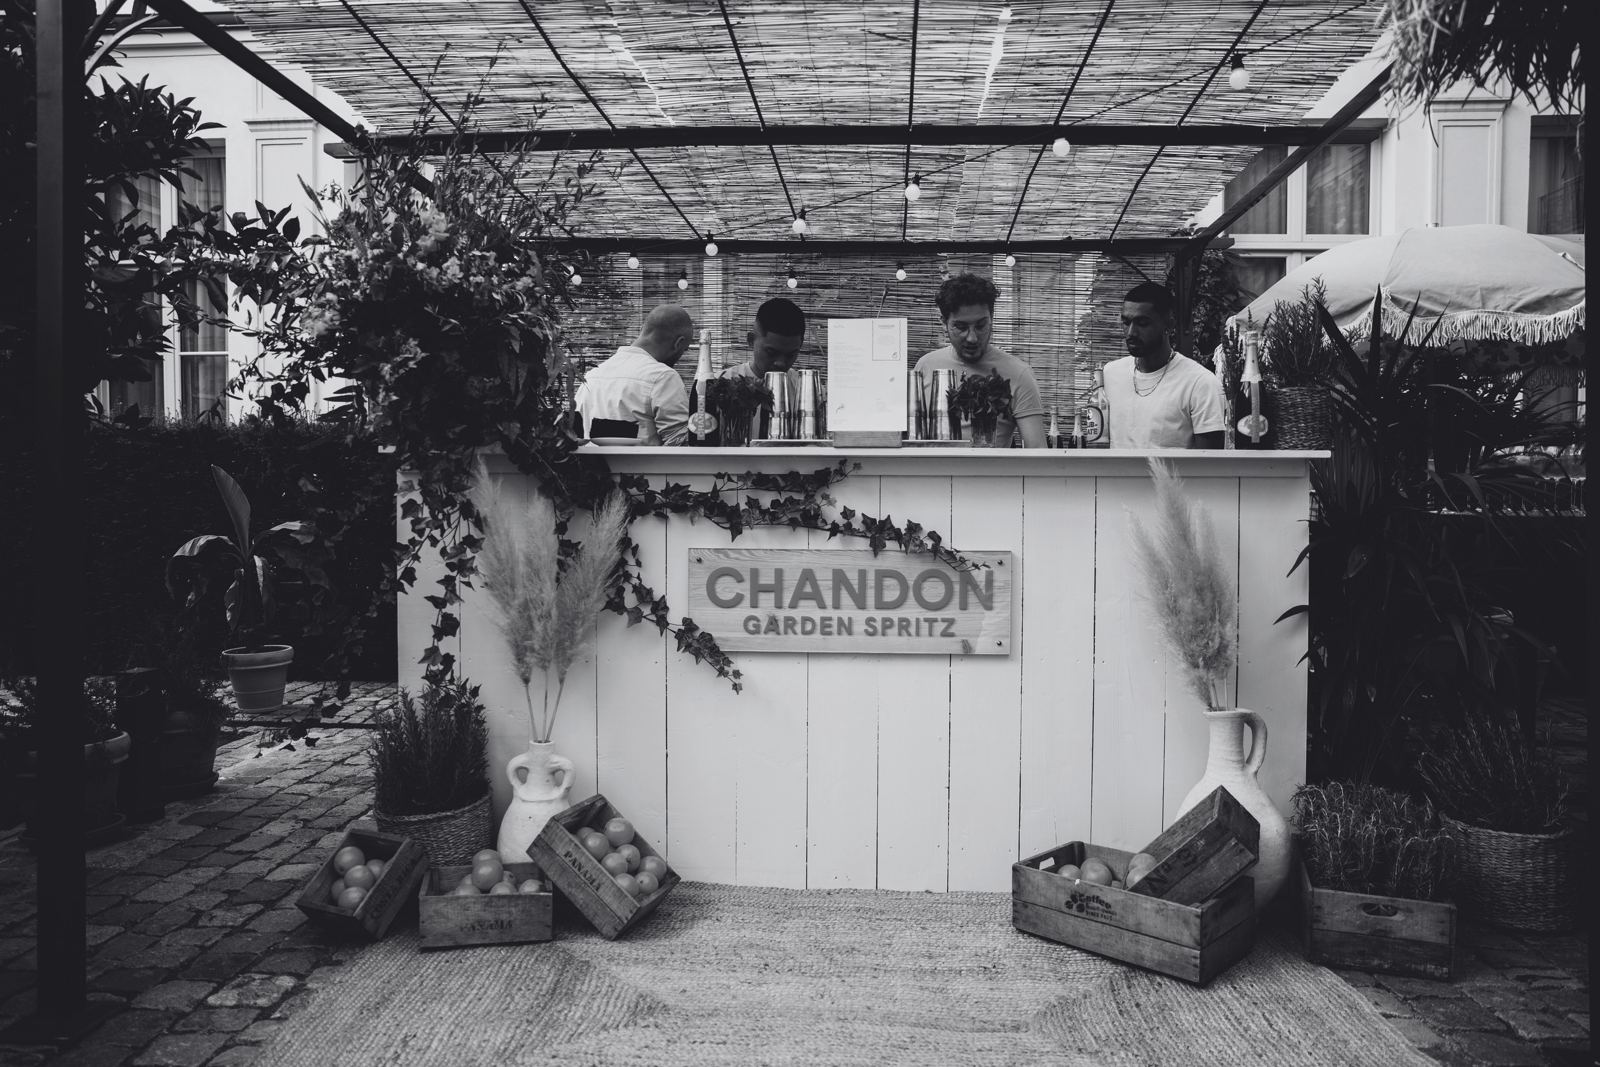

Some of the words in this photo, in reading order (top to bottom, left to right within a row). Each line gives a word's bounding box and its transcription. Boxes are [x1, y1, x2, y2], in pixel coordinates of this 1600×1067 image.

[705, 566, 994, 611] CHANDON
[743, 614, 854, 636] GARDEN
[864, 616, 956, 637] SPRITZ
